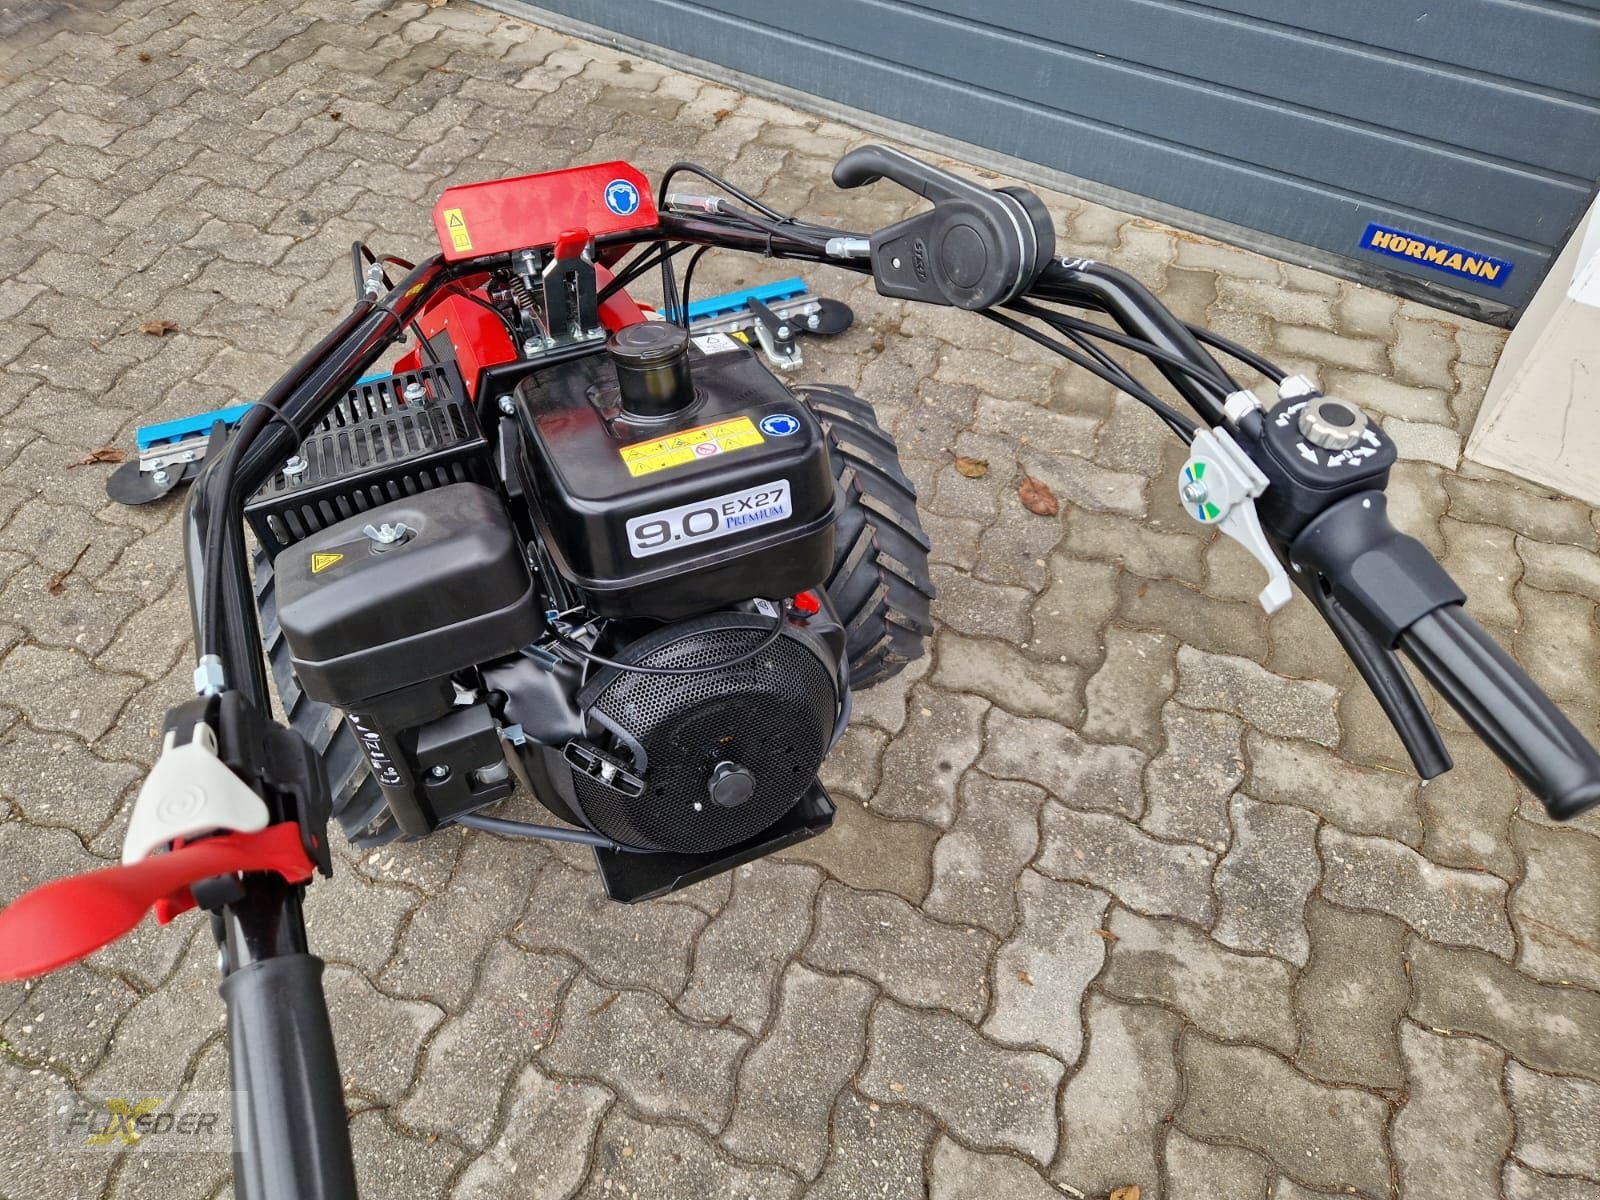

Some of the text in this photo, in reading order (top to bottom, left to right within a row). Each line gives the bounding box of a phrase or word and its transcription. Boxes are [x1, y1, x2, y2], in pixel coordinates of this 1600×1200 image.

[1371, 230, 1501, 281] HÖRMANN
[634, 488, 784, 550] 9.0 EX27
[725, 503, 785, 530] PREMIUM
